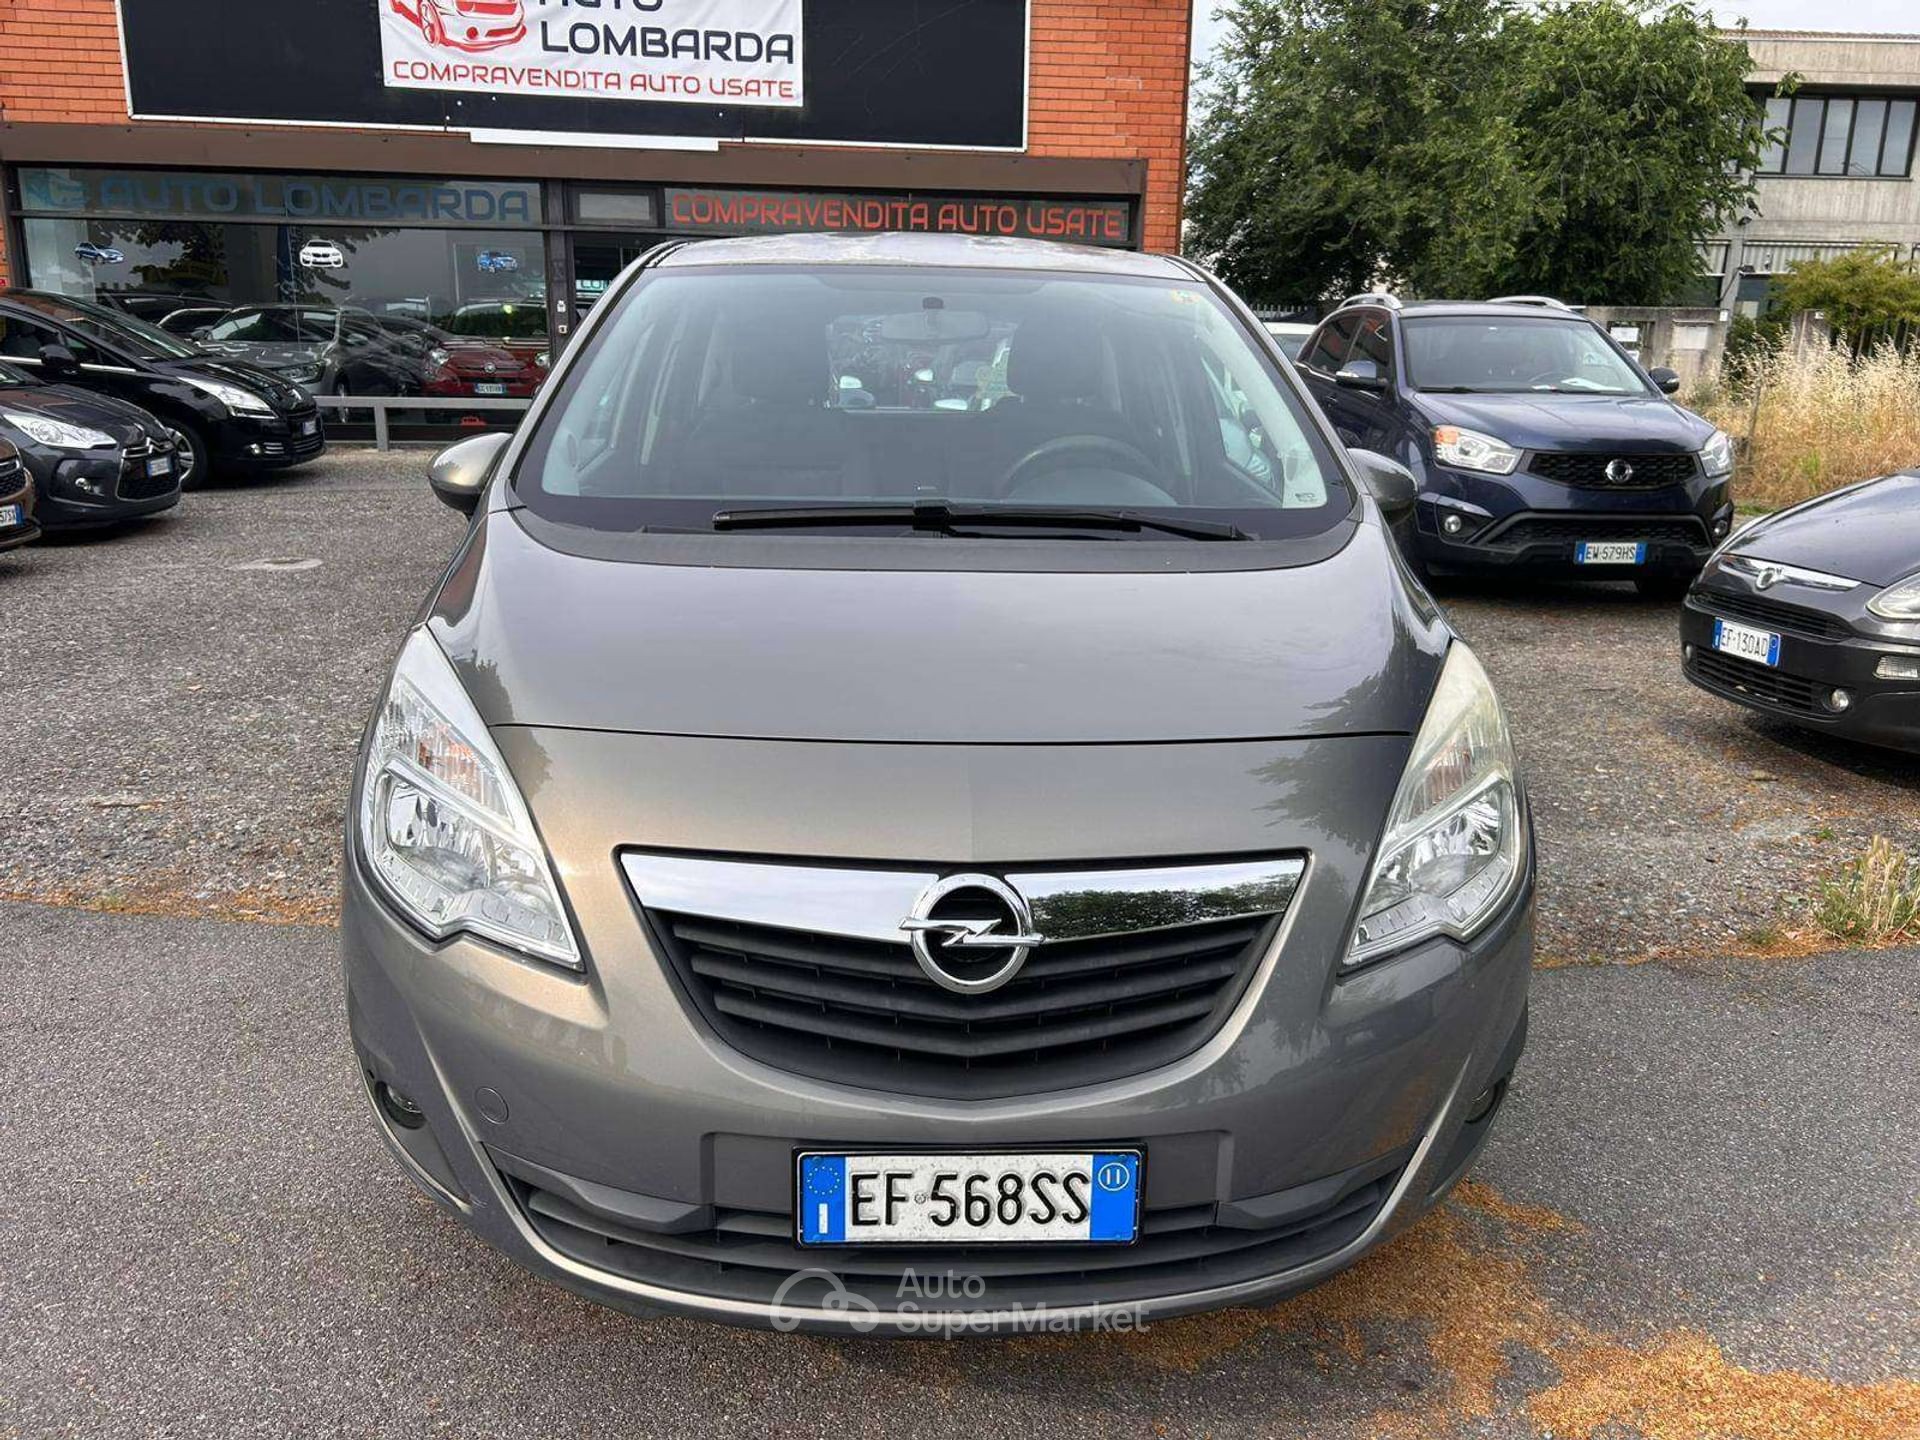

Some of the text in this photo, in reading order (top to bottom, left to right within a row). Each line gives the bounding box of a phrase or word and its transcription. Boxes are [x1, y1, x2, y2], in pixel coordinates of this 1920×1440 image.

[540, 20, 793, 64] LOMBARDA
[393, 61, 794, 98] COMPRAVENDITA AUTO USATE
[100, 177, 529, 222] AUTO LOMBARDA
[671, 193, 1122, 238] COMPRAVENDITA AUTO USATE
